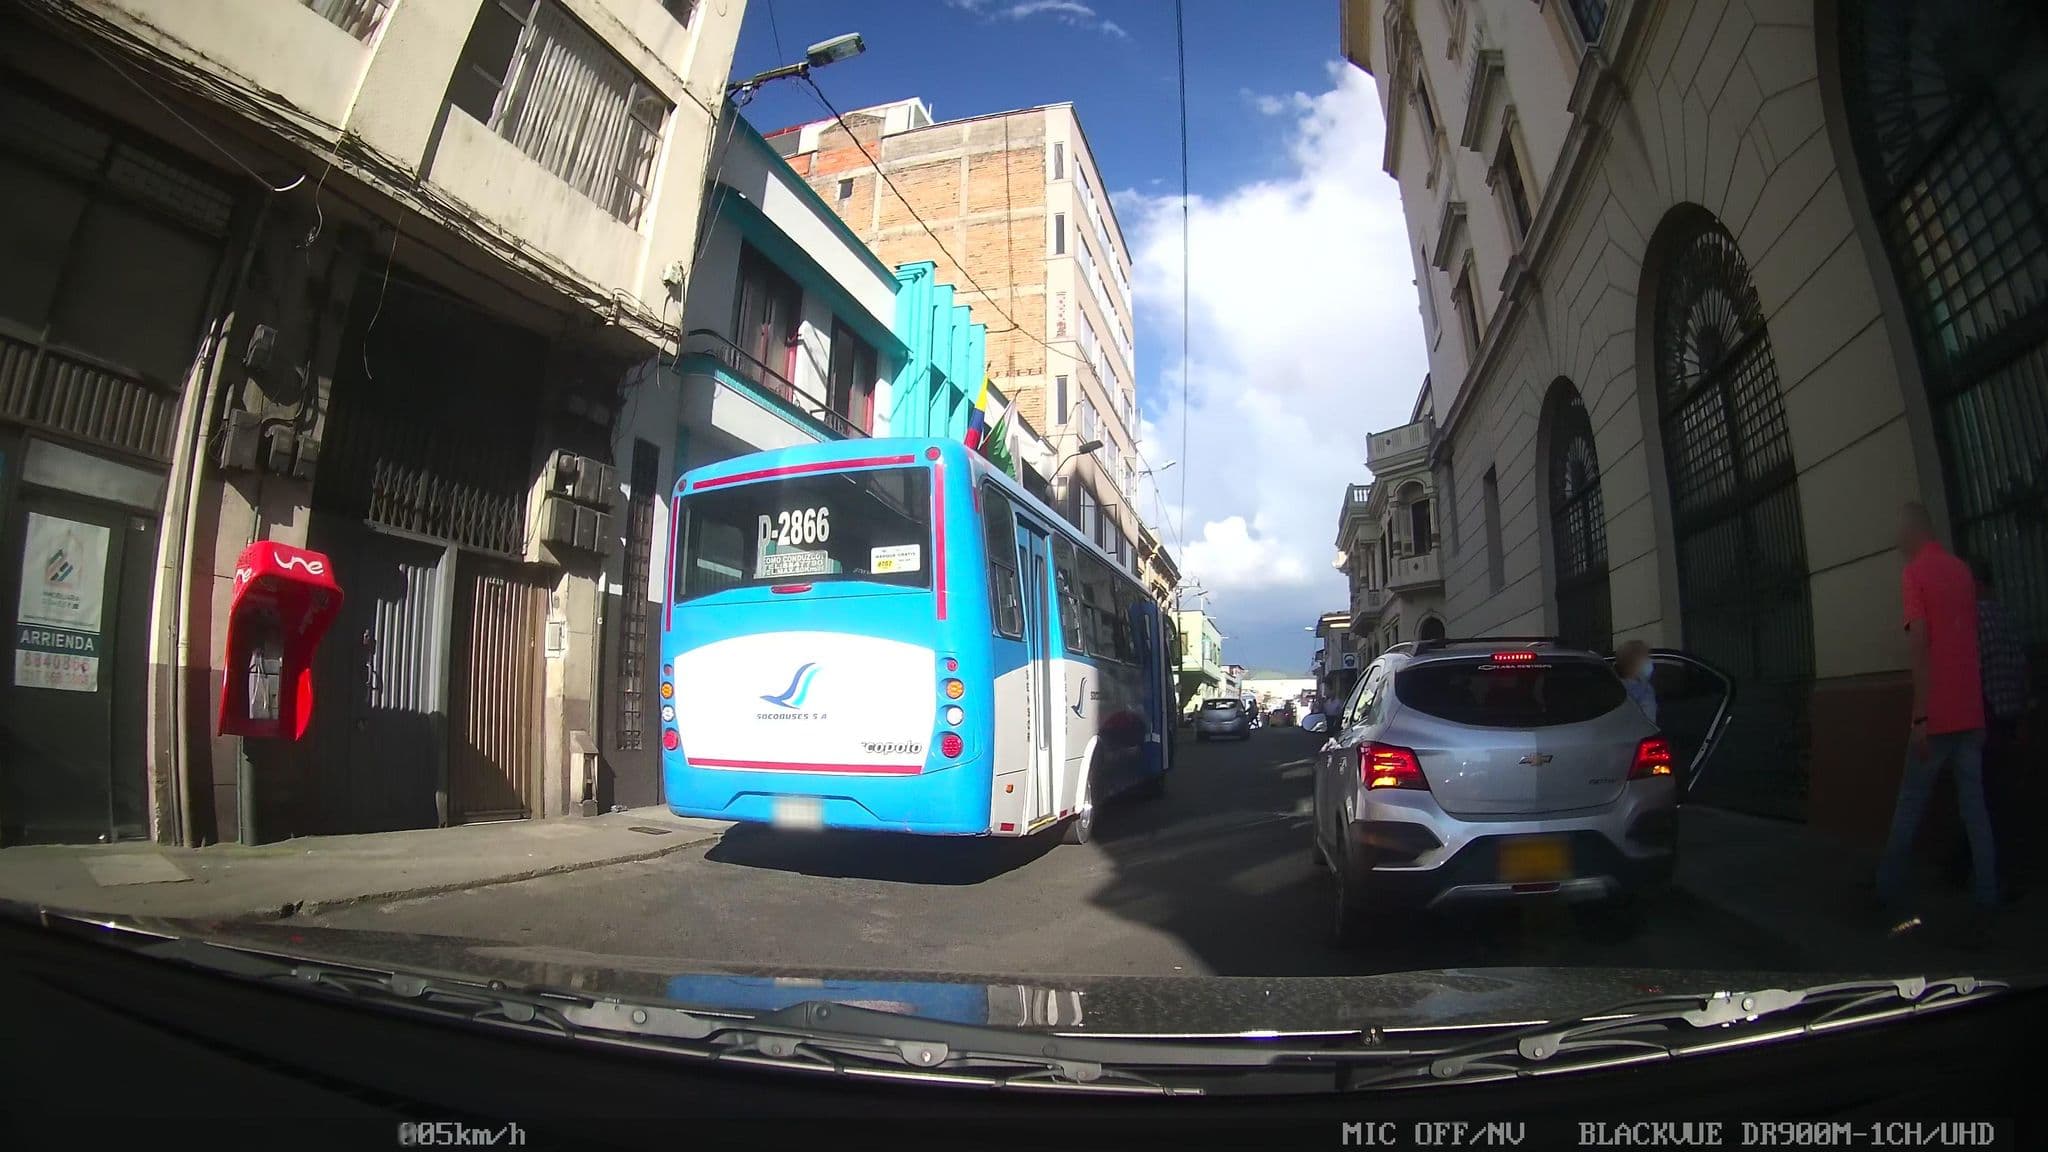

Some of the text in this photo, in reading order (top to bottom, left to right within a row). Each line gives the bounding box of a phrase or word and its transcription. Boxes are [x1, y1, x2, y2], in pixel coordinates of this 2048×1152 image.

[758, 506, 830, 546] D-2866
[274, 551, 324, 575] une
[234, 567, 252, 583] ne
[20, 629, 94, 652] ARRIENDA
